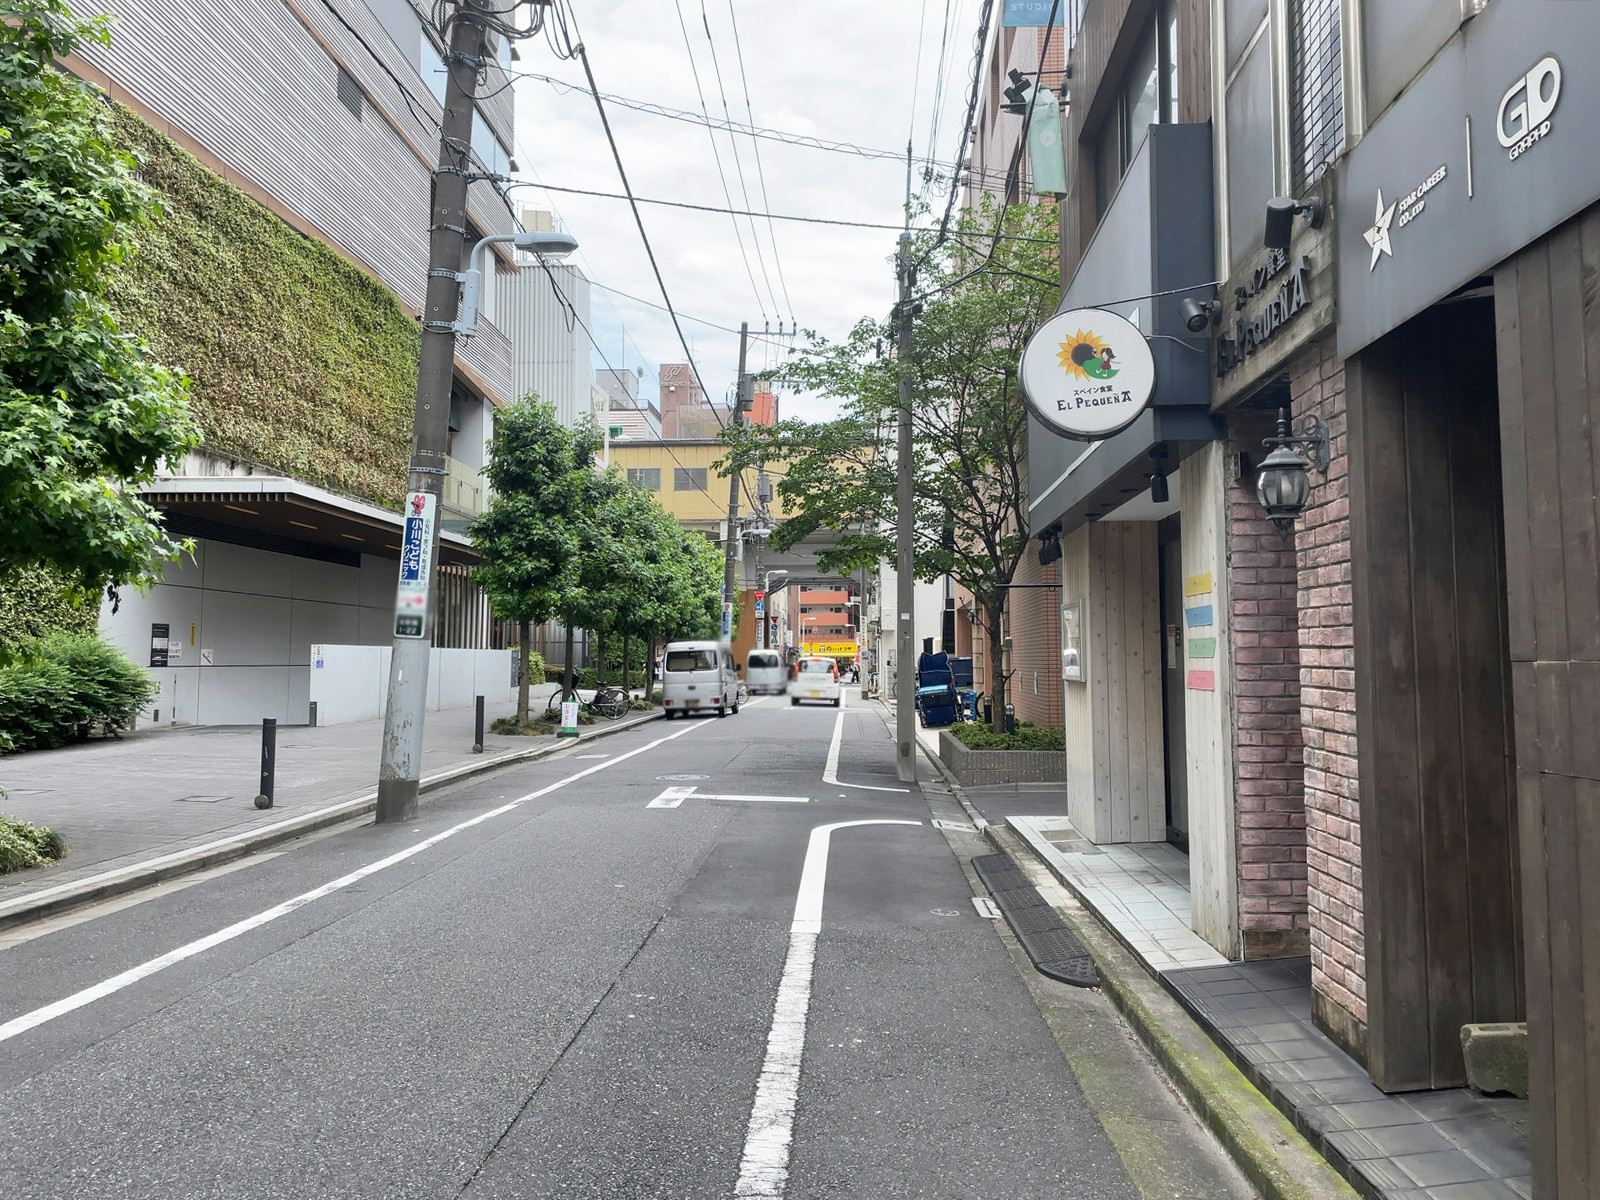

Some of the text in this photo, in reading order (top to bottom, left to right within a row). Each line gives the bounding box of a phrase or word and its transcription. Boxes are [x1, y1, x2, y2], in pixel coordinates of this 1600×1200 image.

[1399, 166, 1446, 214] STAR CAREER
[1073, 385, 1113, 396] スペイン食堂
[402, 544, 410, 579] クリニック
[409, 519, 423, 570] 小川こども
